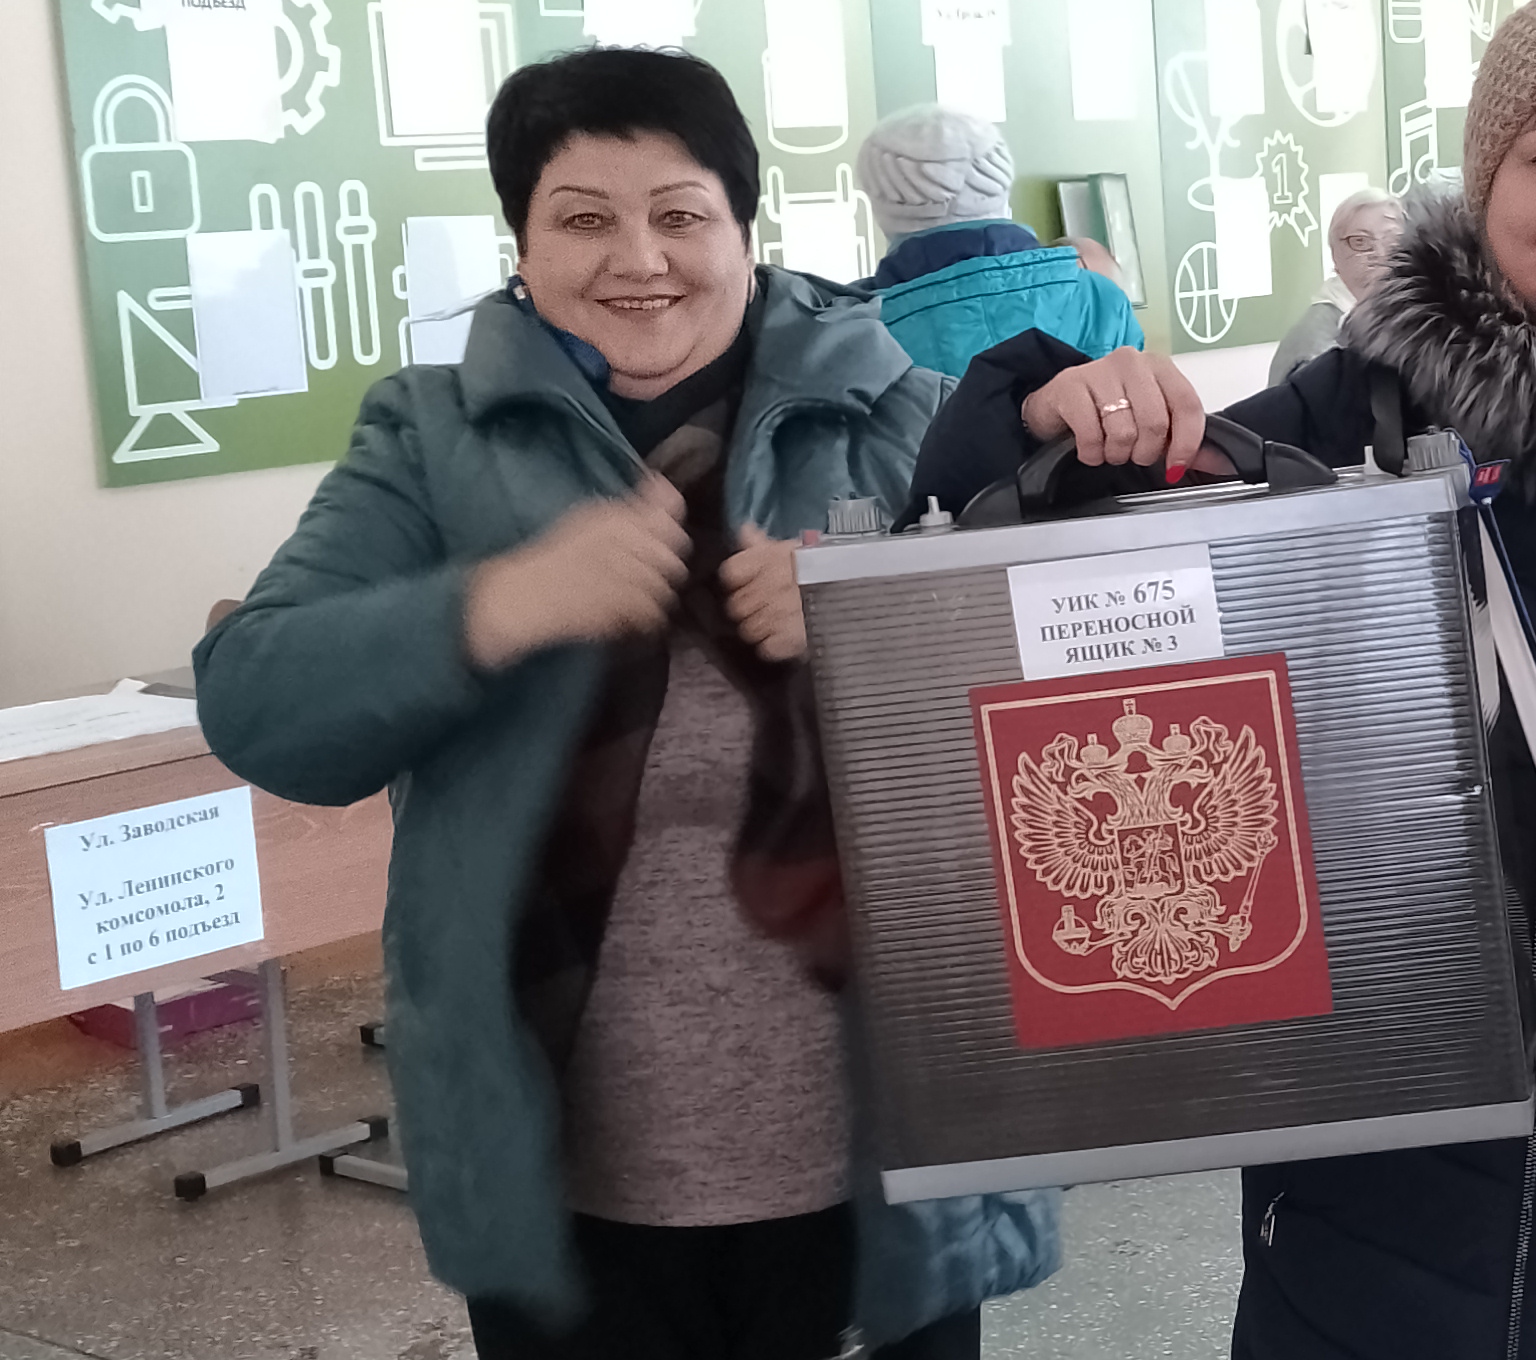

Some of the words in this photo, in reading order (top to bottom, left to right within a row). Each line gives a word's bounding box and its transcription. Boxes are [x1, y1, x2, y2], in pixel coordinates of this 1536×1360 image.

[1051, 593, 1100, 614] УИК
[1105, 591, 1126, 608] №
[1133, 579, 1176, 604] 675
[1040, 604, 1197, 642] ПЕРЕНОСНОЙ
[1065, 639, 1136, 664] ЯЩИК
[1142, 637, 1163, 655] №
[1167, 634, 1178, 651] 3
[79, 832, 115, 852] Ул.
[119, 805, 220, 843] Заводская
[78, 890, 114, 910] Ул.
[118, 858, 235, 900] Ленинского
[96, 892, 210, 934] комсомола,
[215, 883, 225, 901] 2
[87, 951, 97, 965] с
[105, 943, 113, 961] 1
[120, 939, 143, 956] по
[149, 929, 160, 947] 6
[165, 911, 241, 943] подъезд
